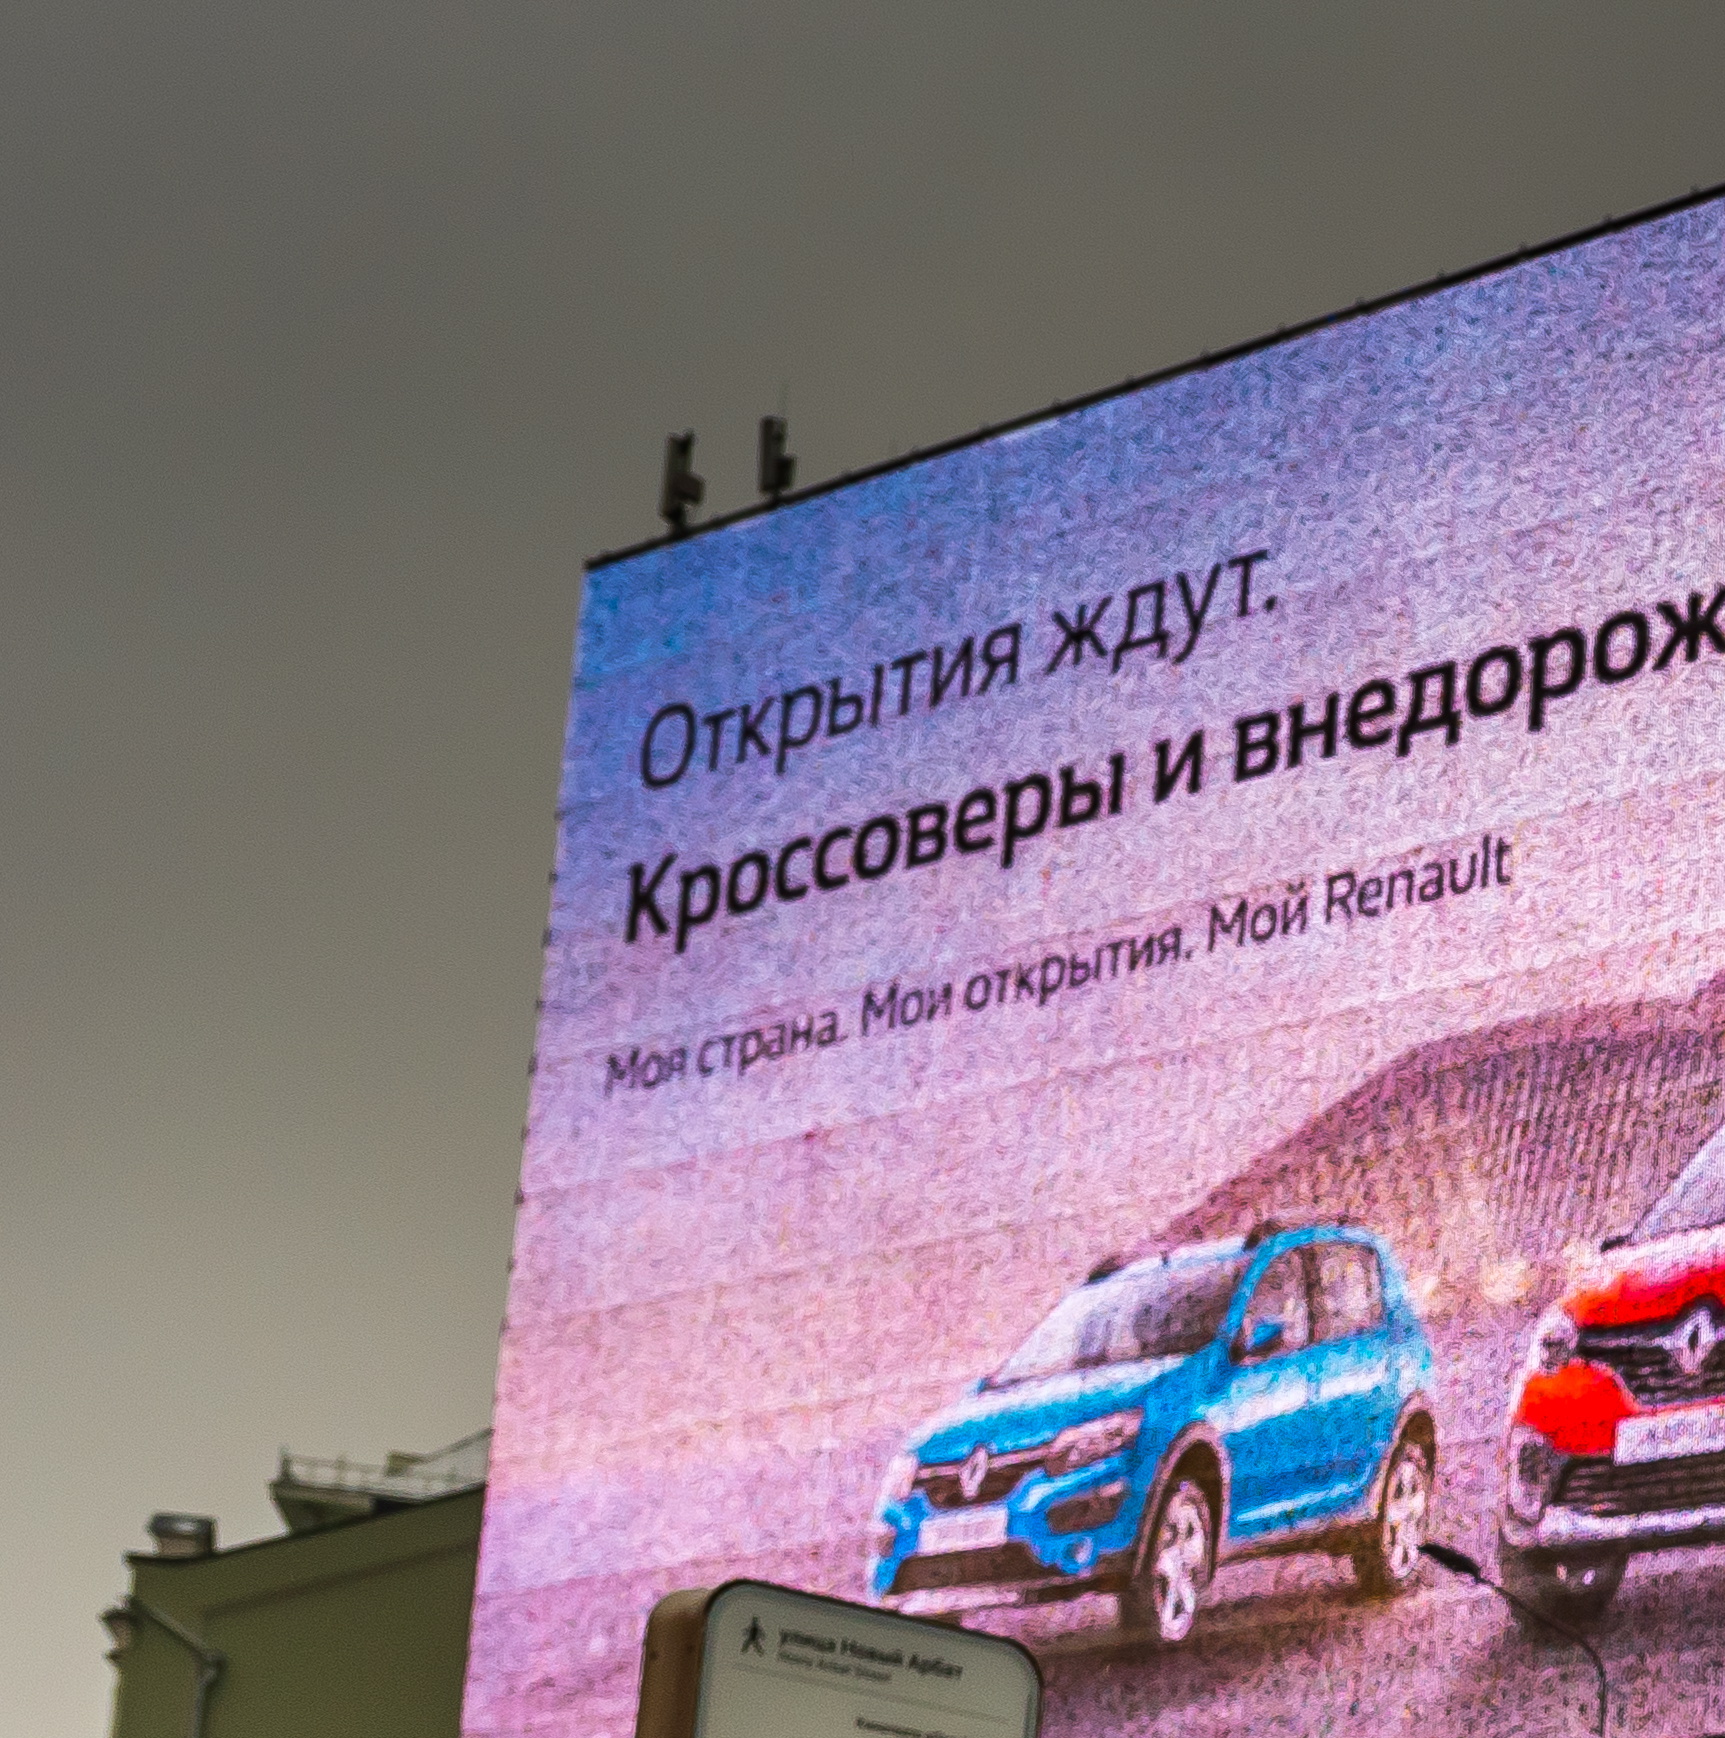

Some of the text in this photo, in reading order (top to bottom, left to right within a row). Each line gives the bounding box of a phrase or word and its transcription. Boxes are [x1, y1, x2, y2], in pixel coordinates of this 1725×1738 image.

[639, 549, 1277, 790] Открытия ждут.
[625, 752, 1126, 953] Кроссоверы
[1153, 728, 1204, 803] и
[605, 833, 1514, 1097] Моя страна. Мои открытия. Мой Renault
